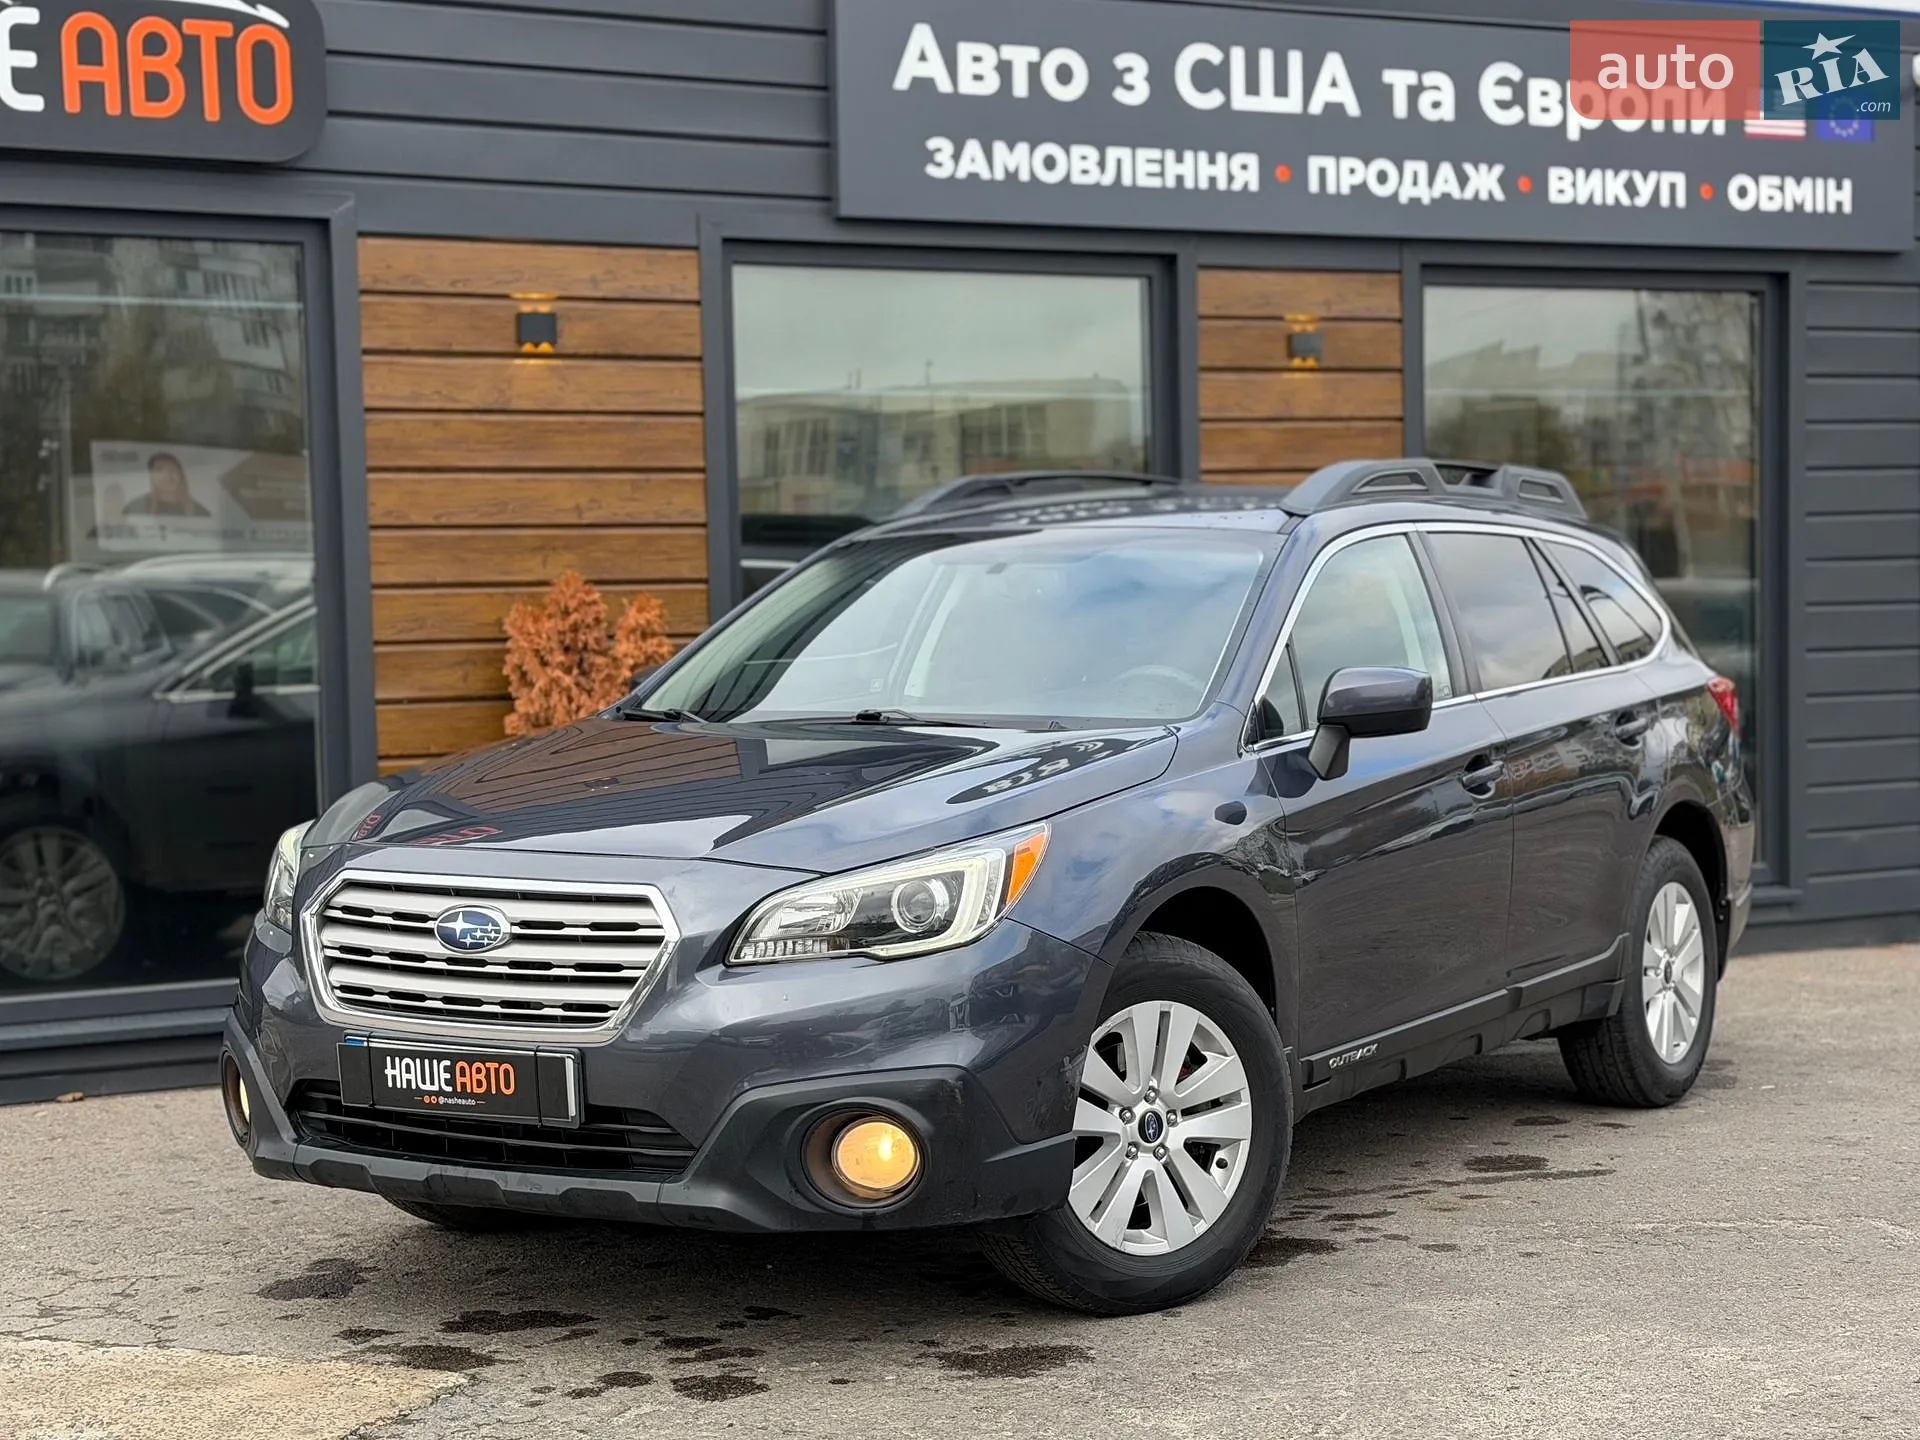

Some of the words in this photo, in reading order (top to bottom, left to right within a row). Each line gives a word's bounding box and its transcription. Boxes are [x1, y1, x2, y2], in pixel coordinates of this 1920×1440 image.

[60, 11, 294, 125] АВТО
[892, 22, 1089, 102] Авто
[1111, 52, 1151, 106] з
[1174, 42, 1361, 118] США
[1381, 68, 1456, 122] та
[924, 136, 1260, 193] ЗАМОВЛЕННЯ
[1307, 155, 1506, 205] ПРОДАЖ
[1547, 166, 1687, 209] ВИКУП
[1727, 173, 1853, 214] ОБМІН
[384, 1055, 453, 1093] НАШЕ
[455, 1060, 516, 1096] АВТО
